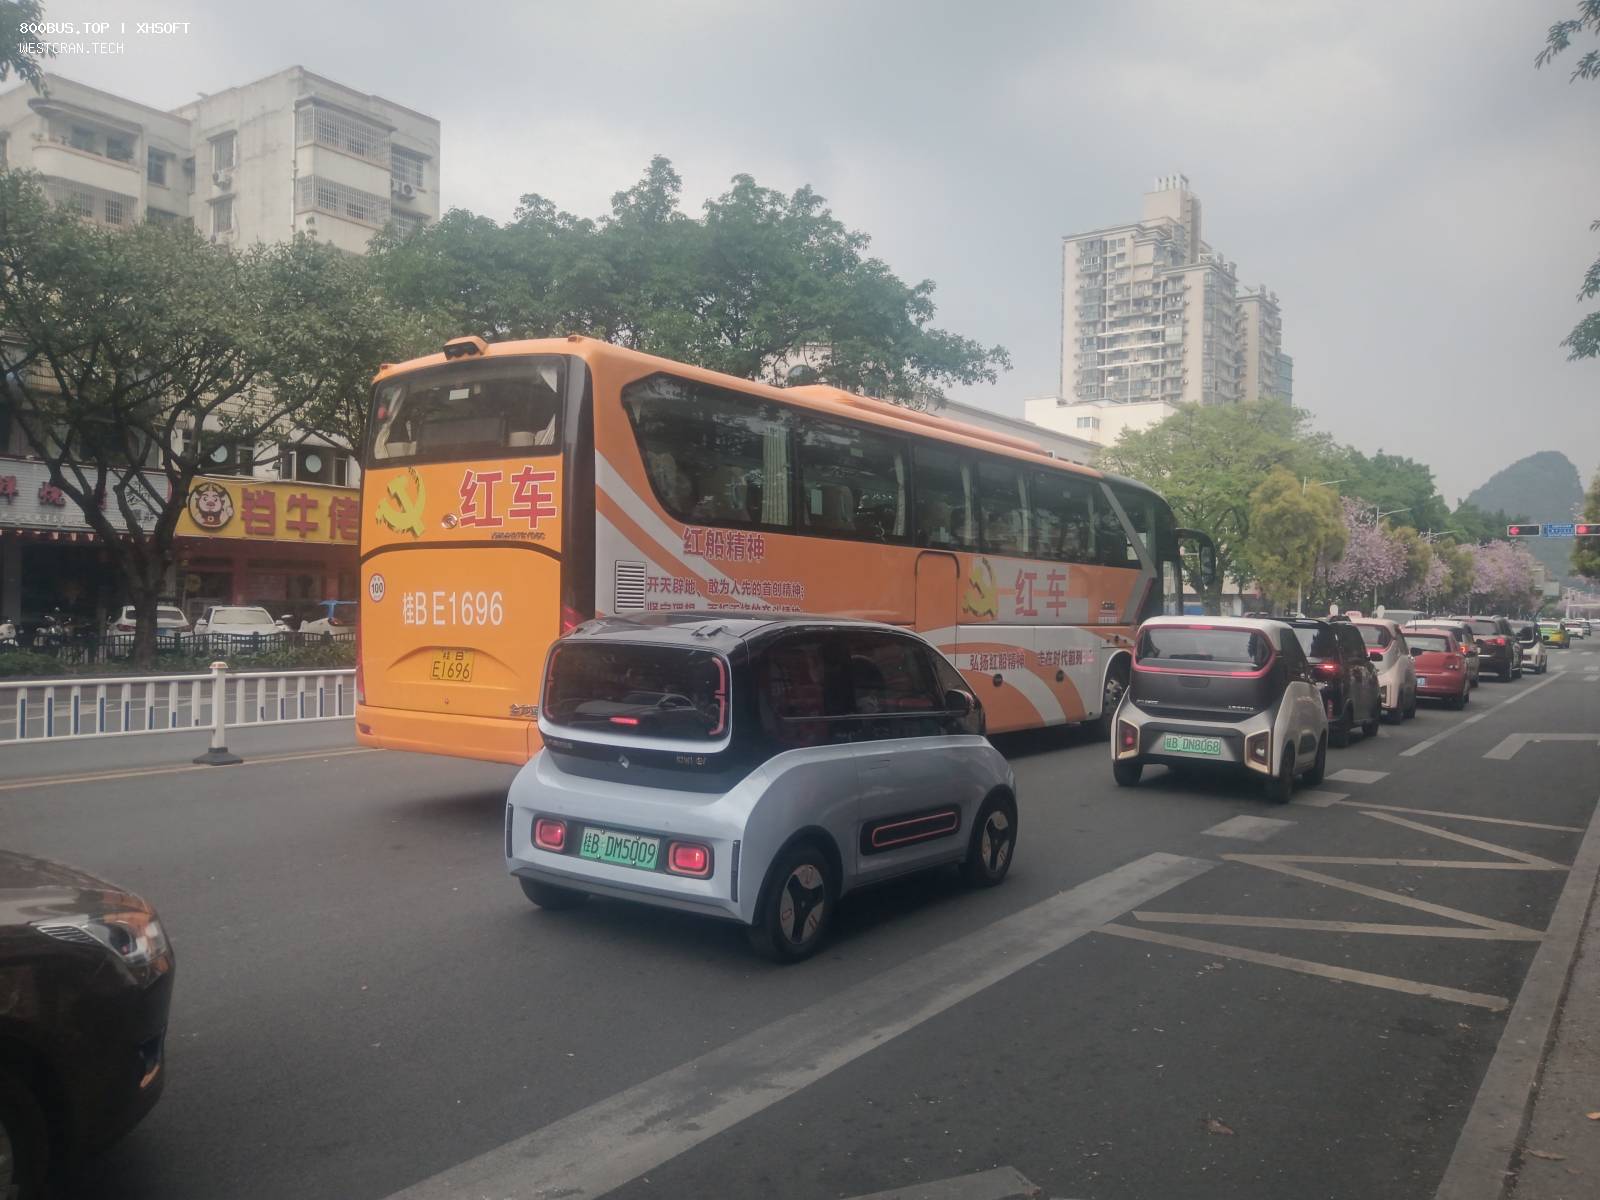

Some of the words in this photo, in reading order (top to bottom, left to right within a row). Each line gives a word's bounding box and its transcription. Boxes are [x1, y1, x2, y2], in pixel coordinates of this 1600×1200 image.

[459, 465, 557, 530] 红车
[683, 527, 766, 561] 红船精神
[371, 582, 384, 594] 100
[1015, 567, 1067, 617] 红车
[432, 661, 470, 679] E1696
